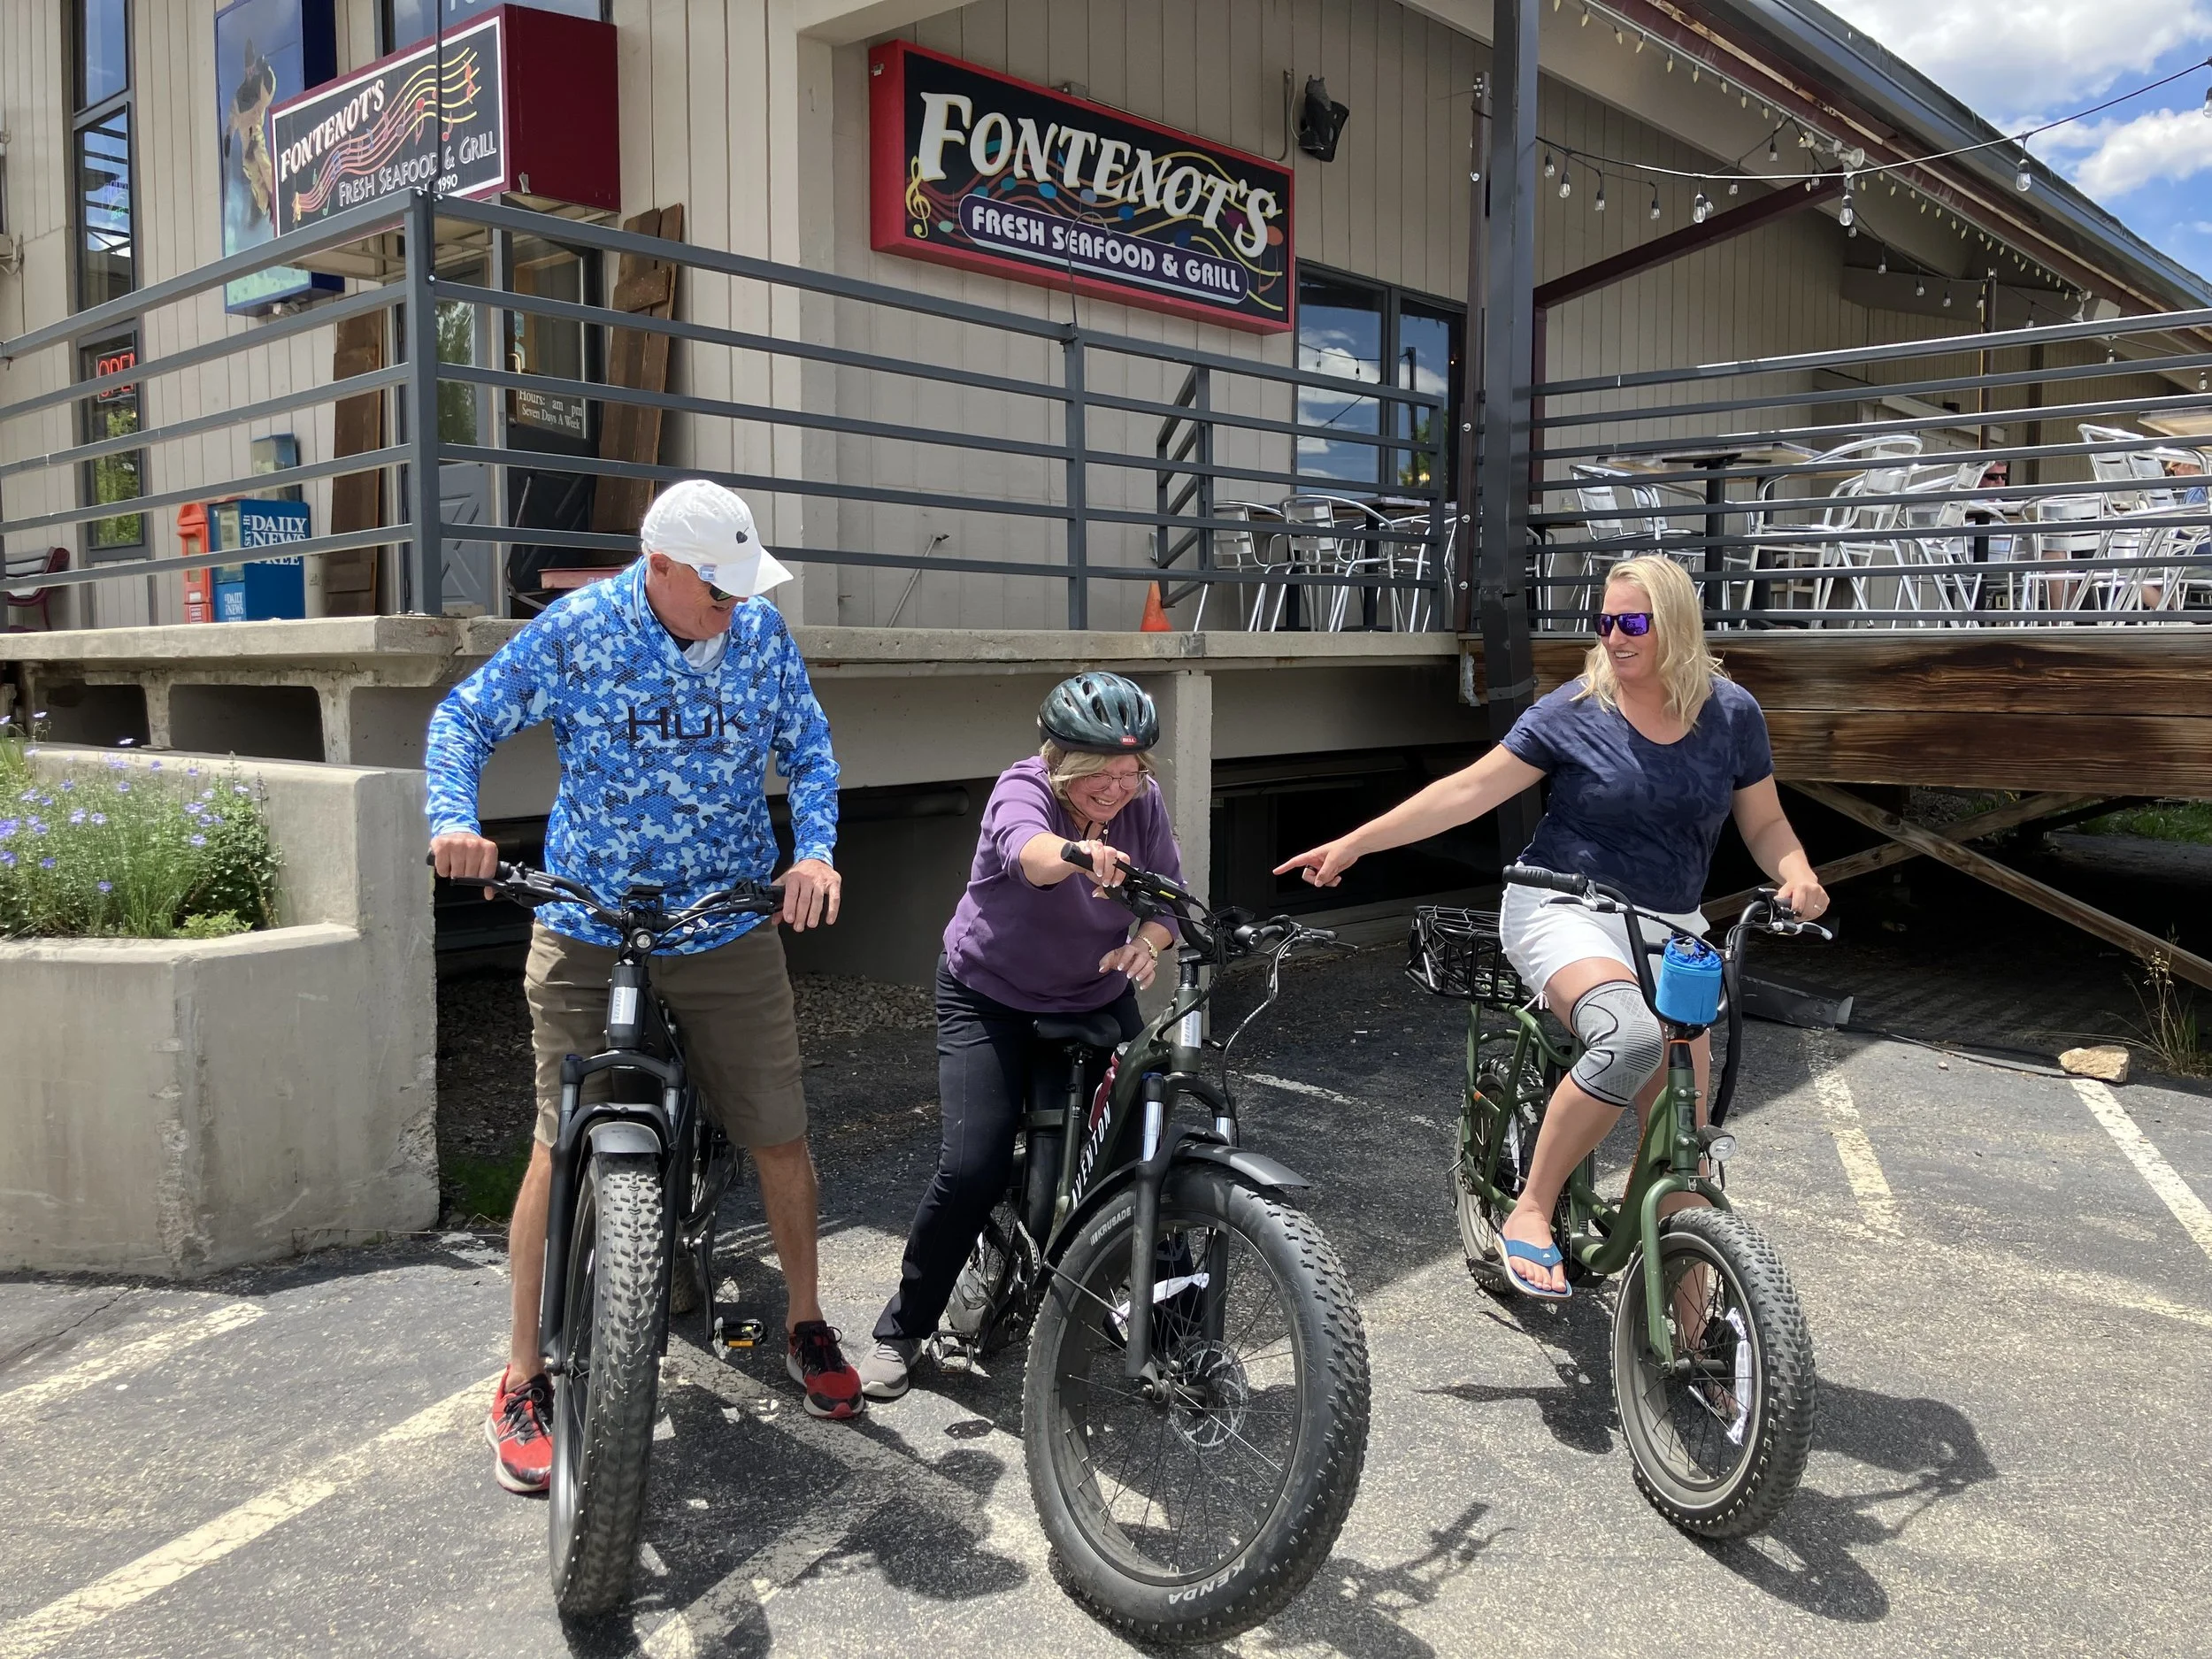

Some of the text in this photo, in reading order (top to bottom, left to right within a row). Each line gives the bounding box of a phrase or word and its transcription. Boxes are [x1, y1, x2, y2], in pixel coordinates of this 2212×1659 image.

[280, 79, 385, 183] FONTENOT'S
[338, 179, 375, 207] FRESH
[379, 152, 437, 194] SEAFOOD
[444, 145, 455, 171] &
[459, 131, 497, 165] GRILL
[438, 174, 457, 191] 1990
[918, 92, 1277, 258] FONTENOT'S
[972, 204, 1240, 293] FRESH SEAFOOD & GRILL
[519, 390, 582, 418] Hours: am pm
[522, 403, 540, 419] Seven
[541, 410, 557, 425] Days
[565, 415, 580, 429] Week
[251, 515, 307, 533] DAILY
[1071, 1101, 1112, 1210] AVENTON
[1097, 1205, 1132, 1238] KRUSADE
[1168, 1557, 1246, 1605] KENDA
